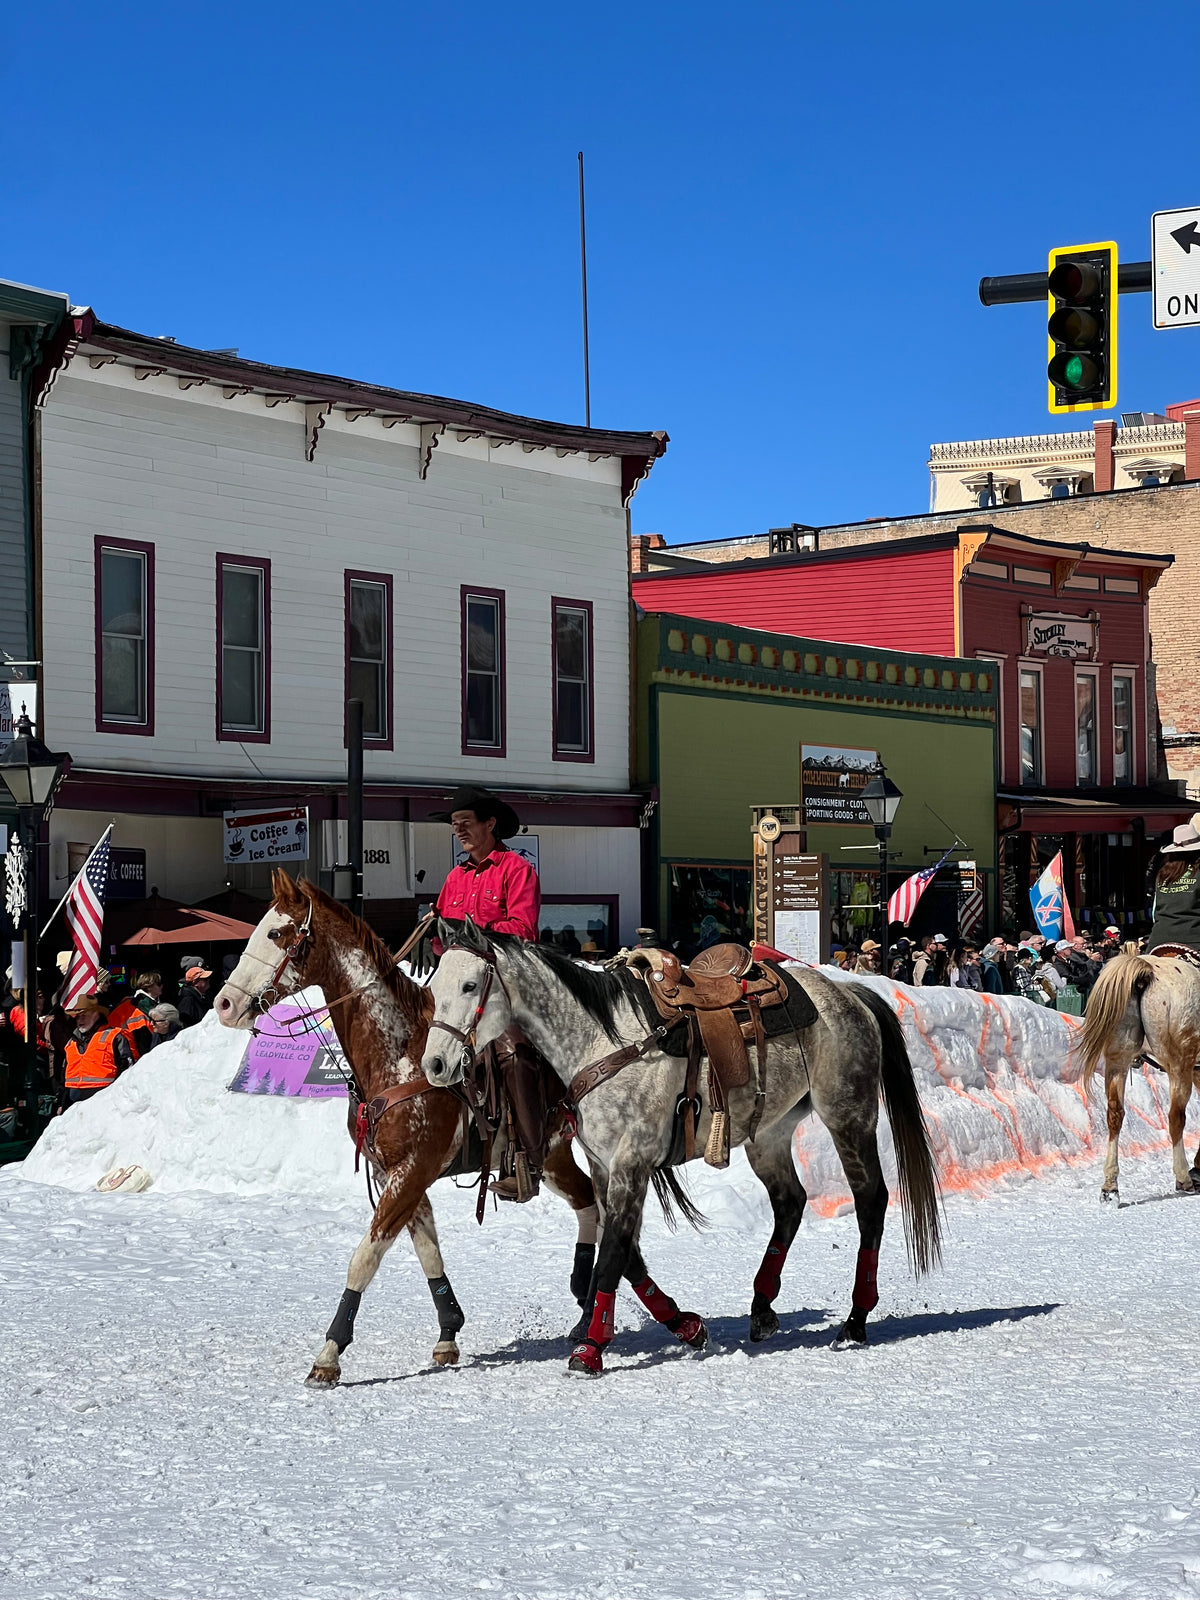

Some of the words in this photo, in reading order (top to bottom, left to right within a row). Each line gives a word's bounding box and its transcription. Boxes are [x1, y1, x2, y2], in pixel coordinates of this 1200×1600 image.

[1167, 293, 1199, 317] ON
[805, 797, 846, 808] CONSIGNMENT
[849, 800, 867, 810] CLOT
[806, 808, 834, 819] SPORTING
[834, 810, 855, 821] GOODS
[250, 824, 289, 842] Coffee
[248, 849, 265, 861] Ice
[267, 842, 302, 857] Cream
[363, 849, 391, 865] 1881
[120, 863, 144, 881] COFFEE
[755, 854, 769, 946] LEADVIL
[257, 1040, 274, 1049] 1017
[275, 1042, 306, 1052] POPLAR
[297, 1053, 311, 1061] CO
